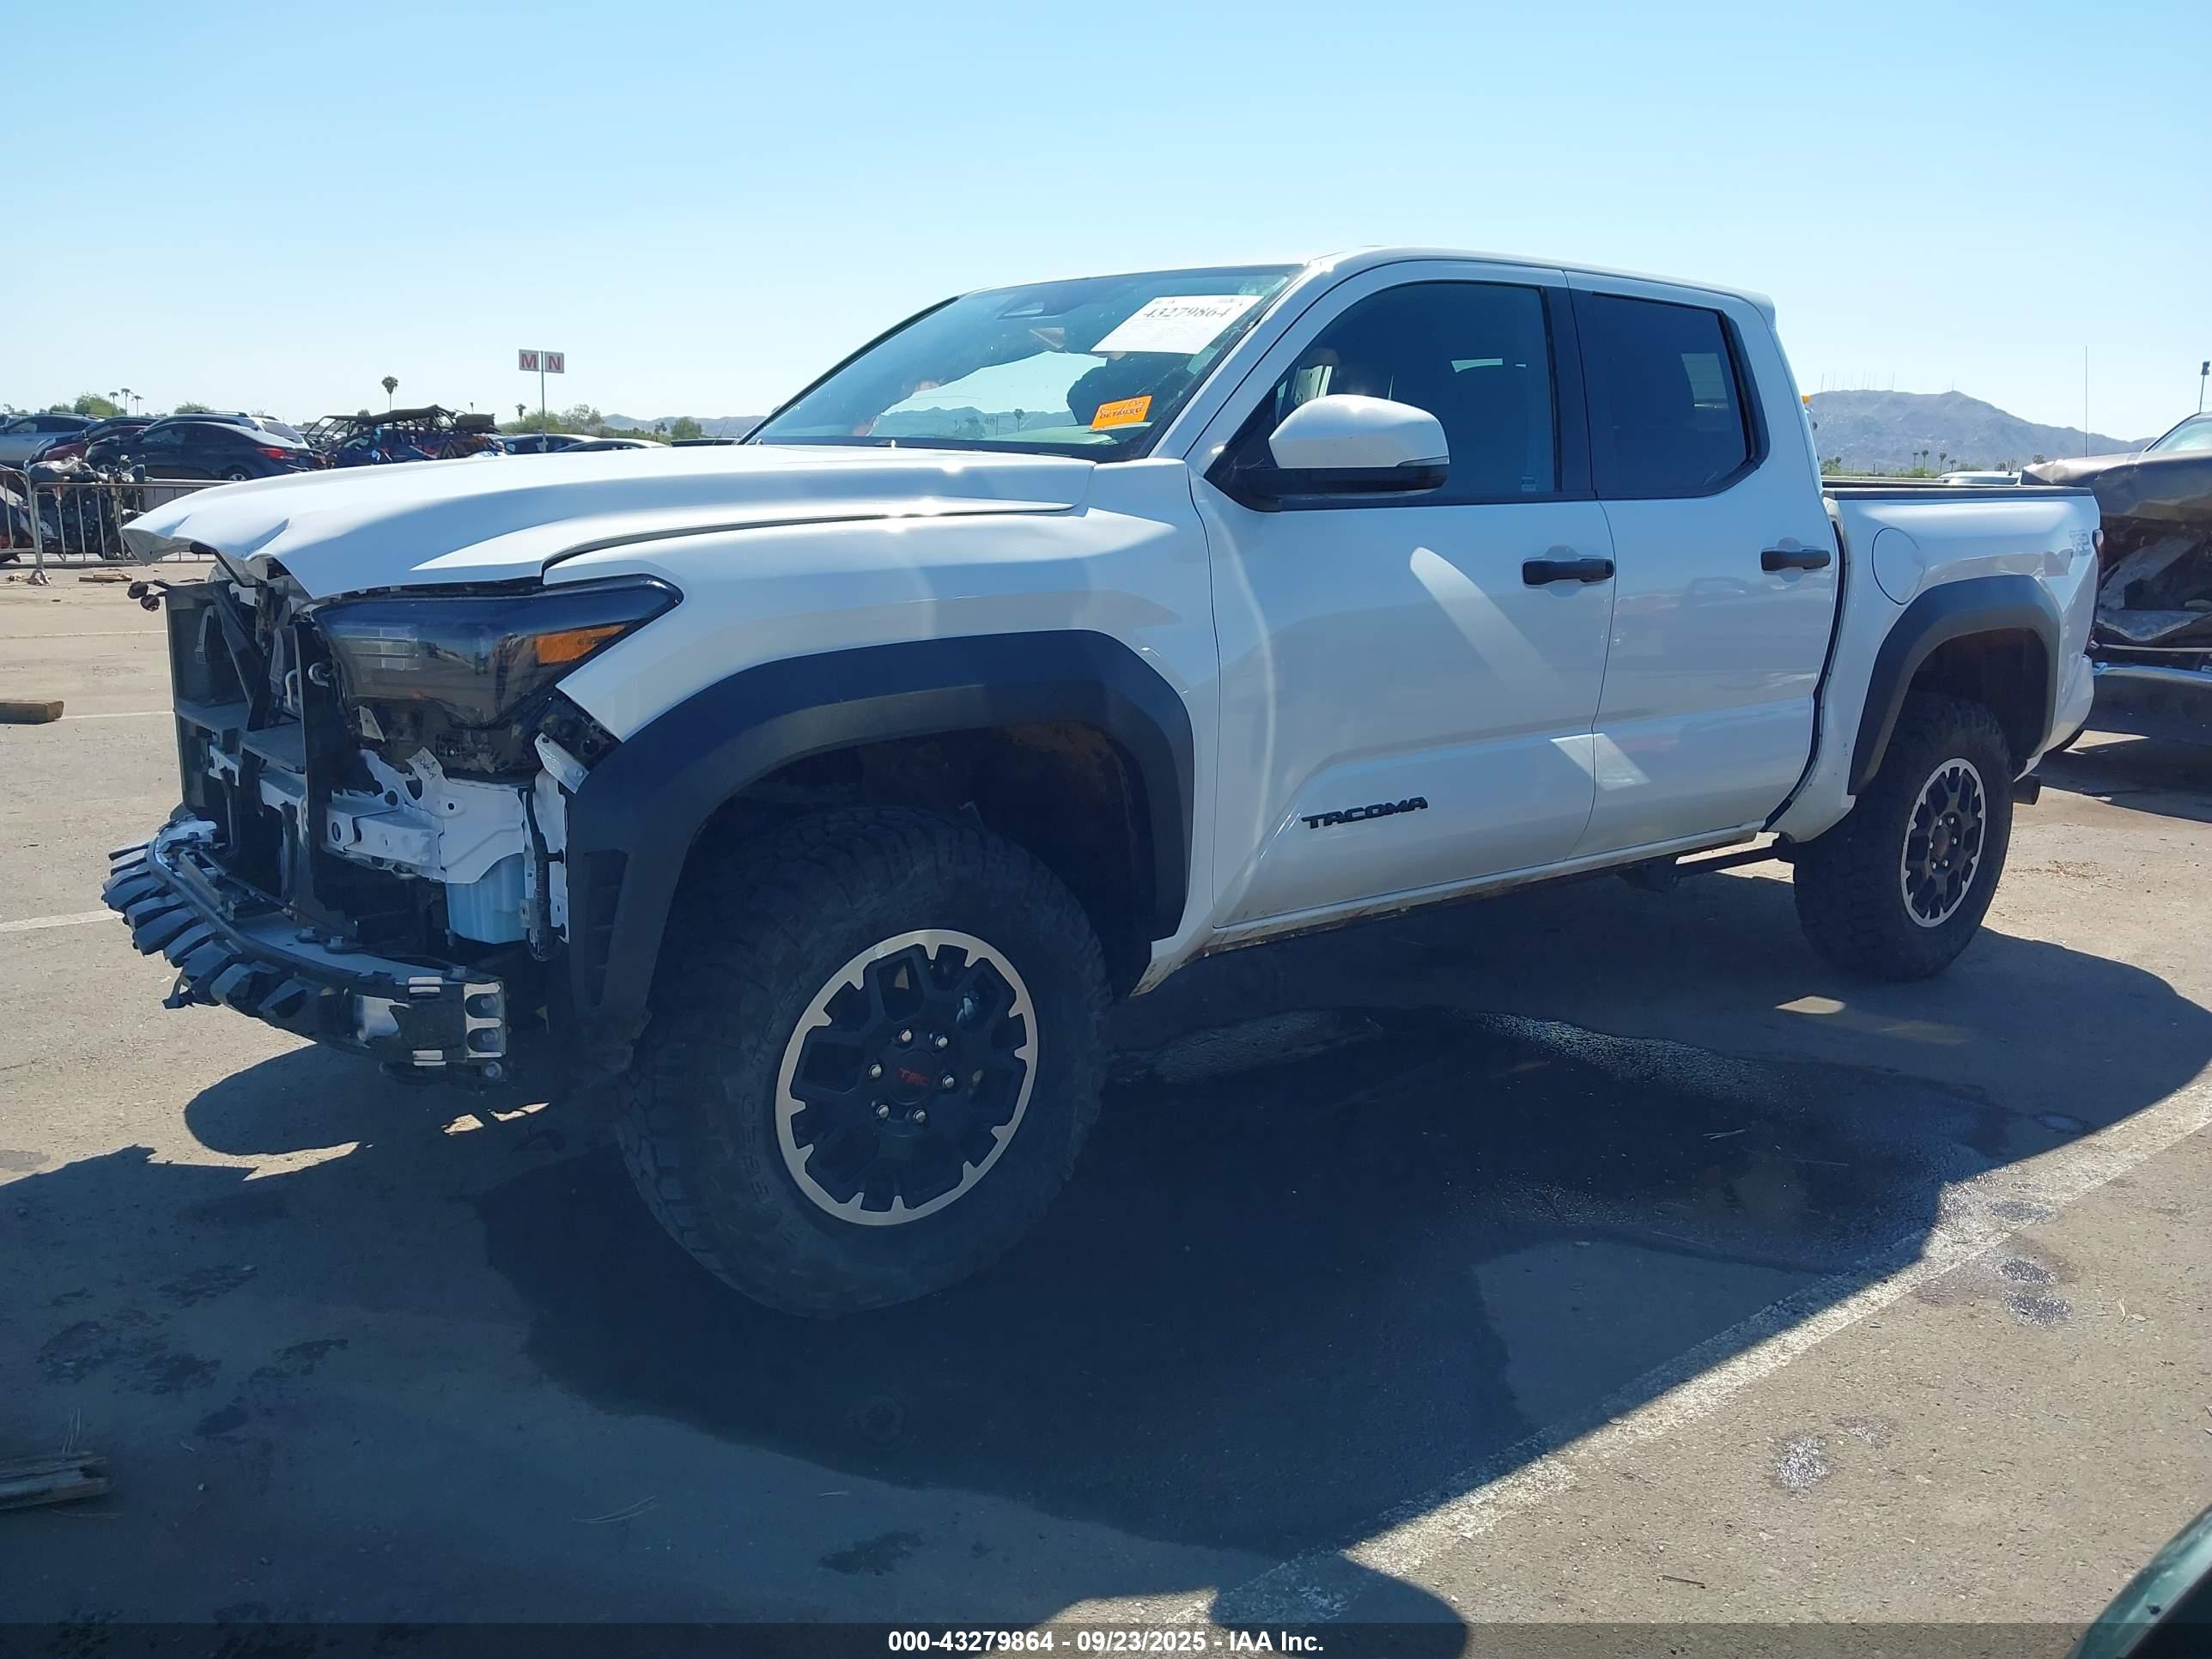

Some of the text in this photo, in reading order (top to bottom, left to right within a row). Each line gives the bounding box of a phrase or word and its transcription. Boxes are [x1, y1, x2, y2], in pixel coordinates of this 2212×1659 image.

[521, 353, 537, 368] M
[548, 355, 561, 371] N
[1301, 796, 1429, 830] TACOMA
